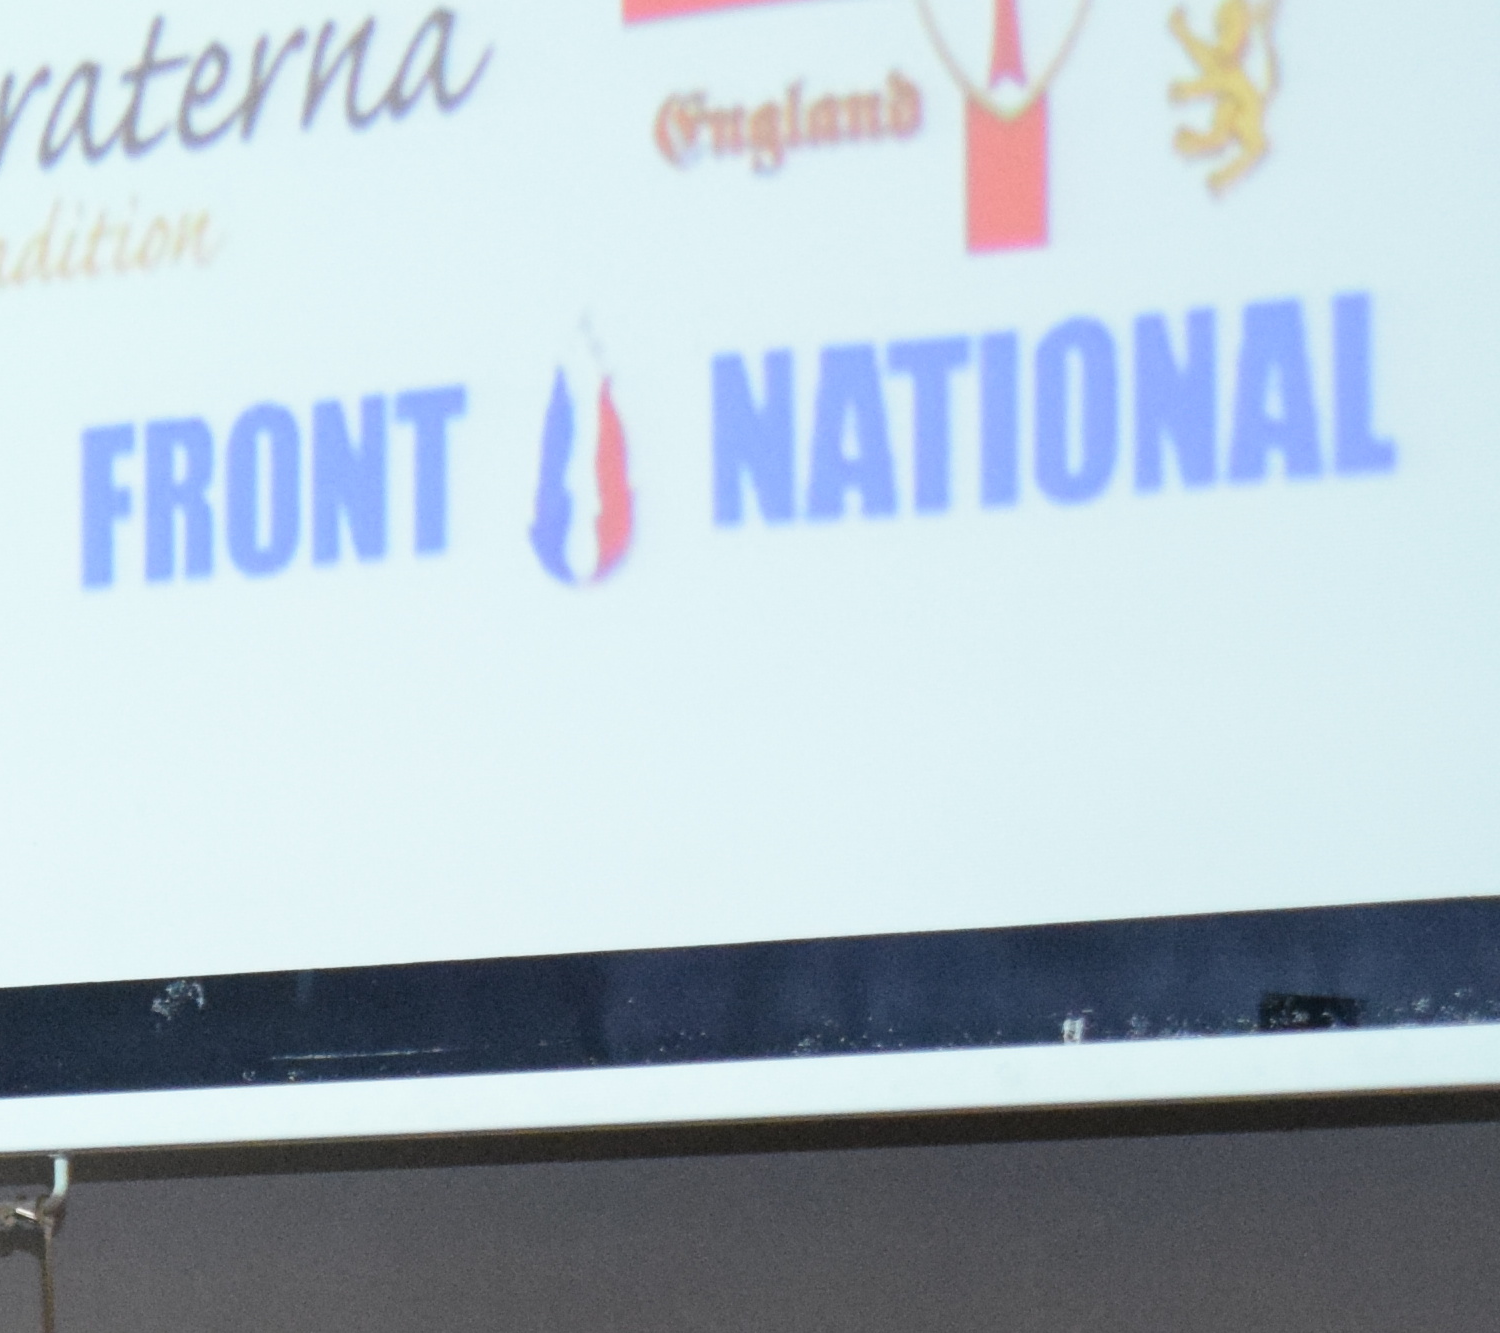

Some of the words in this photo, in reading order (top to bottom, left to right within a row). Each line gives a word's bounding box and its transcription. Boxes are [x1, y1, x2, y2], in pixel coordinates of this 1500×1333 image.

[654, 68, 924, 176] England
[80, 384, 467, 590] FRONT
[711, 290, 1399, 528] NATIONAL
